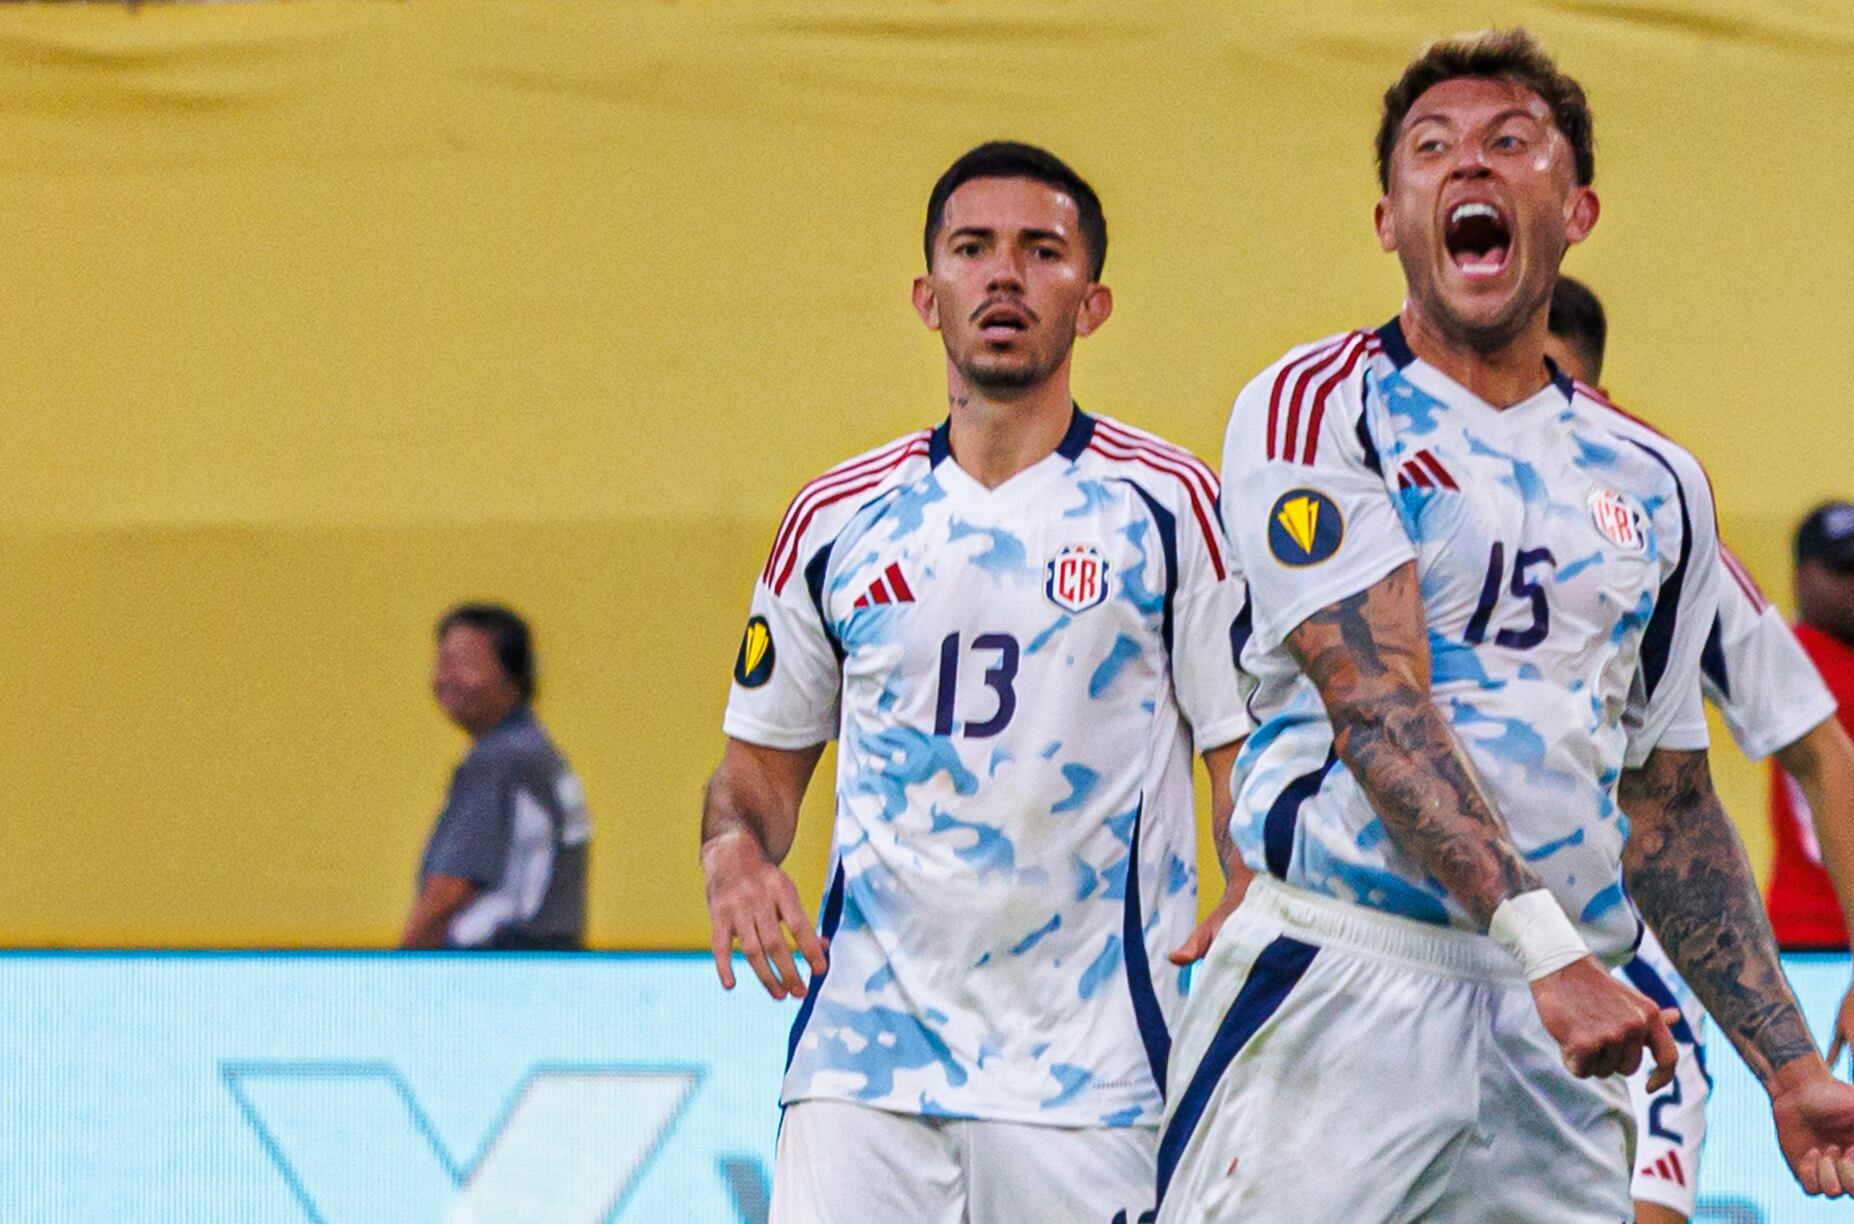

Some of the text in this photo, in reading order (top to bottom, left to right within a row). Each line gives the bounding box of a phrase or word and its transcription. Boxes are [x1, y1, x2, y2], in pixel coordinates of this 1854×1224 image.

[1059, 559, 1097, 603] CR
[1463, 541, 1557, 650] 15
[933, 631, 1020, 738] 13
